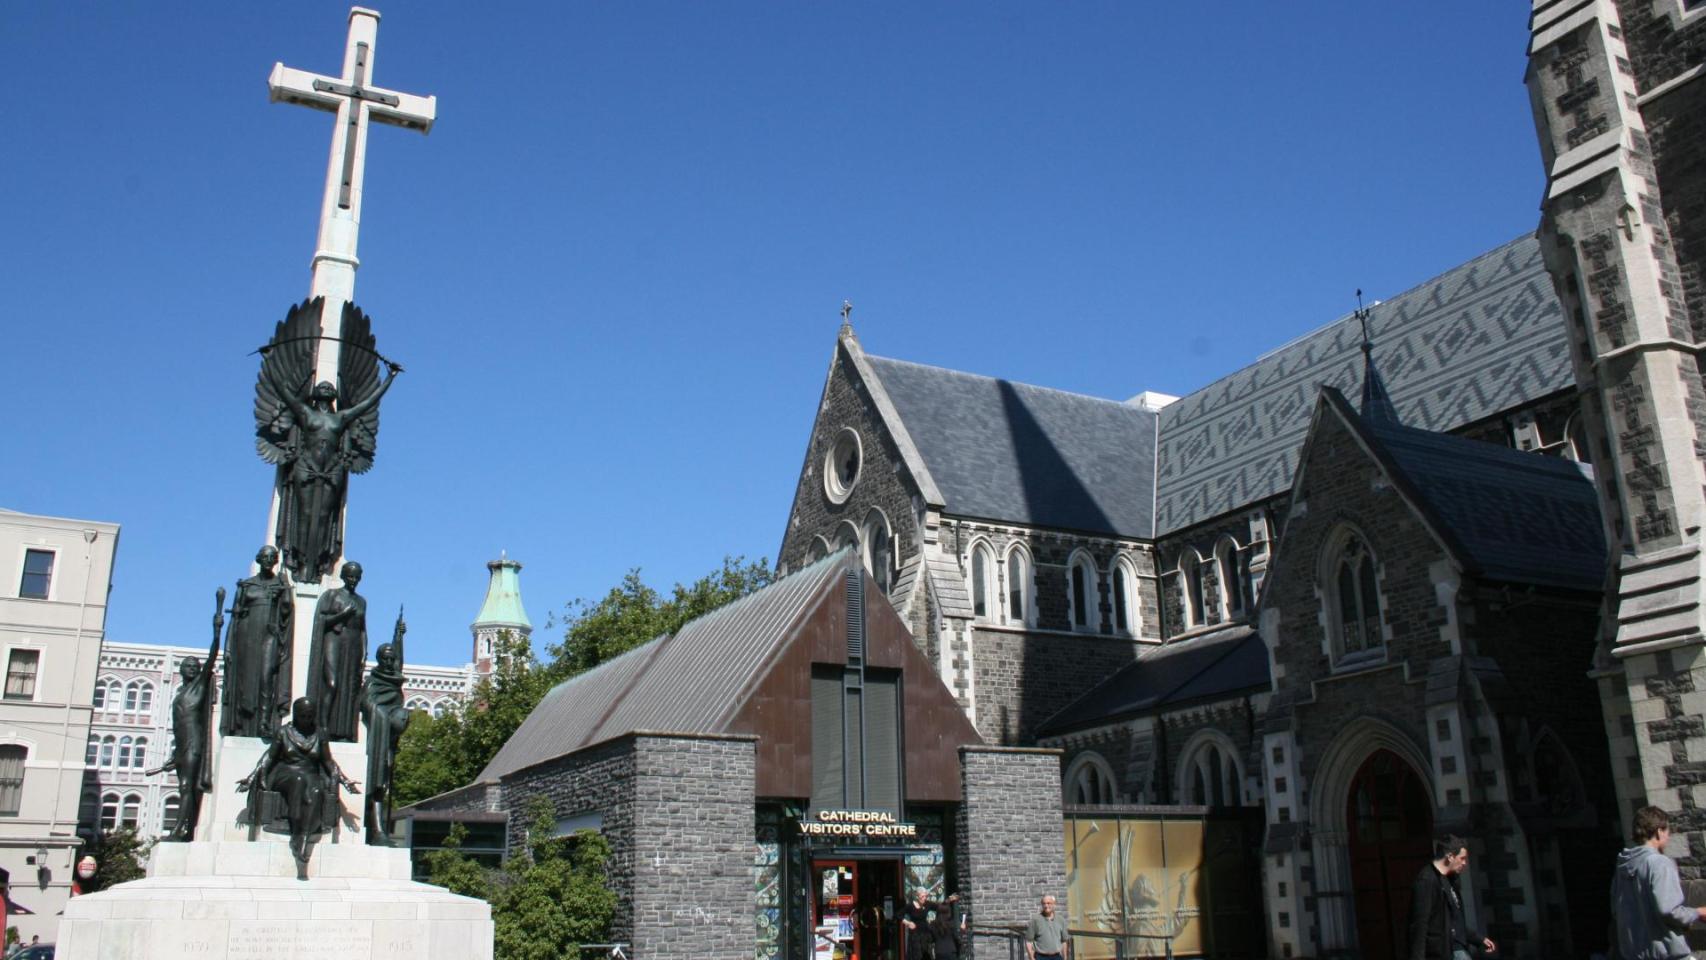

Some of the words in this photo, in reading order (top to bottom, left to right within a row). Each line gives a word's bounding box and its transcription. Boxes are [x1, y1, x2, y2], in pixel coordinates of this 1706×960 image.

[820, 810, 896, 822] CATHEDRAL
[800, 823, 863, 834] VISITORS'
[865, 824, 916, 835] CENTRE
